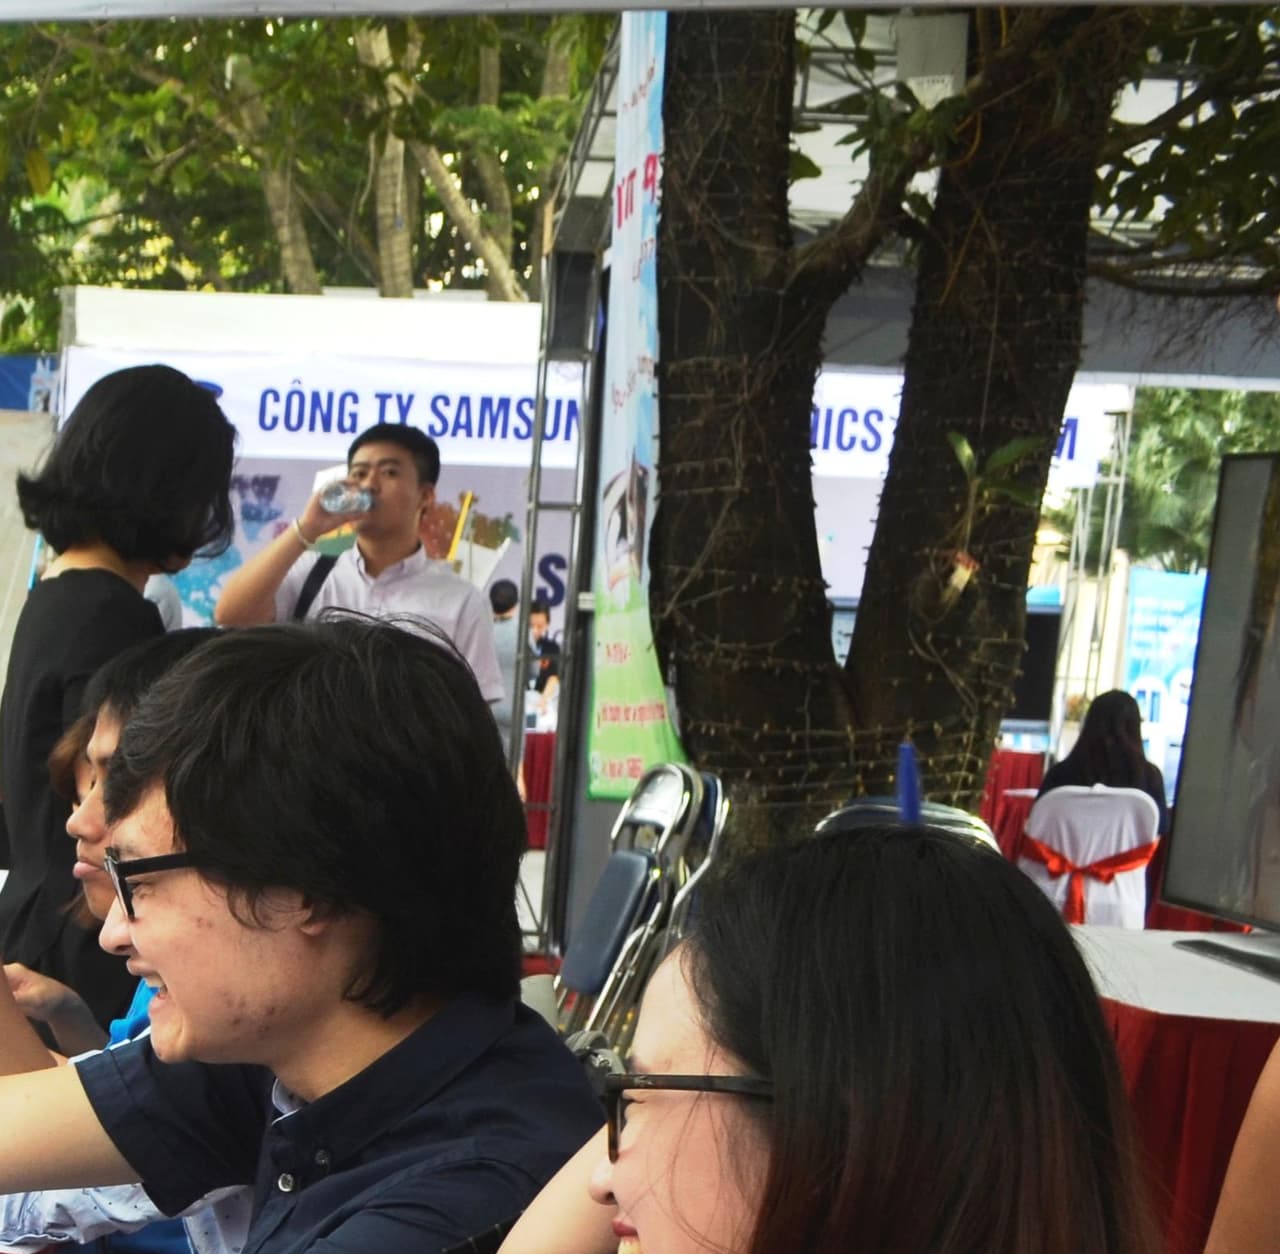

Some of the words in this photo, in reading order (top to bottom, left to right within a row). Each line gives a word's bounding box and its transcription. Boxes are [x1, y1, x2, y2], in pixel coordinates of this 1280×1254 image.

[258, 379, 359, 434] CÔNG
[375, 393, 414, 426] TY
[428, 394, 582, 442] SAMSUN
